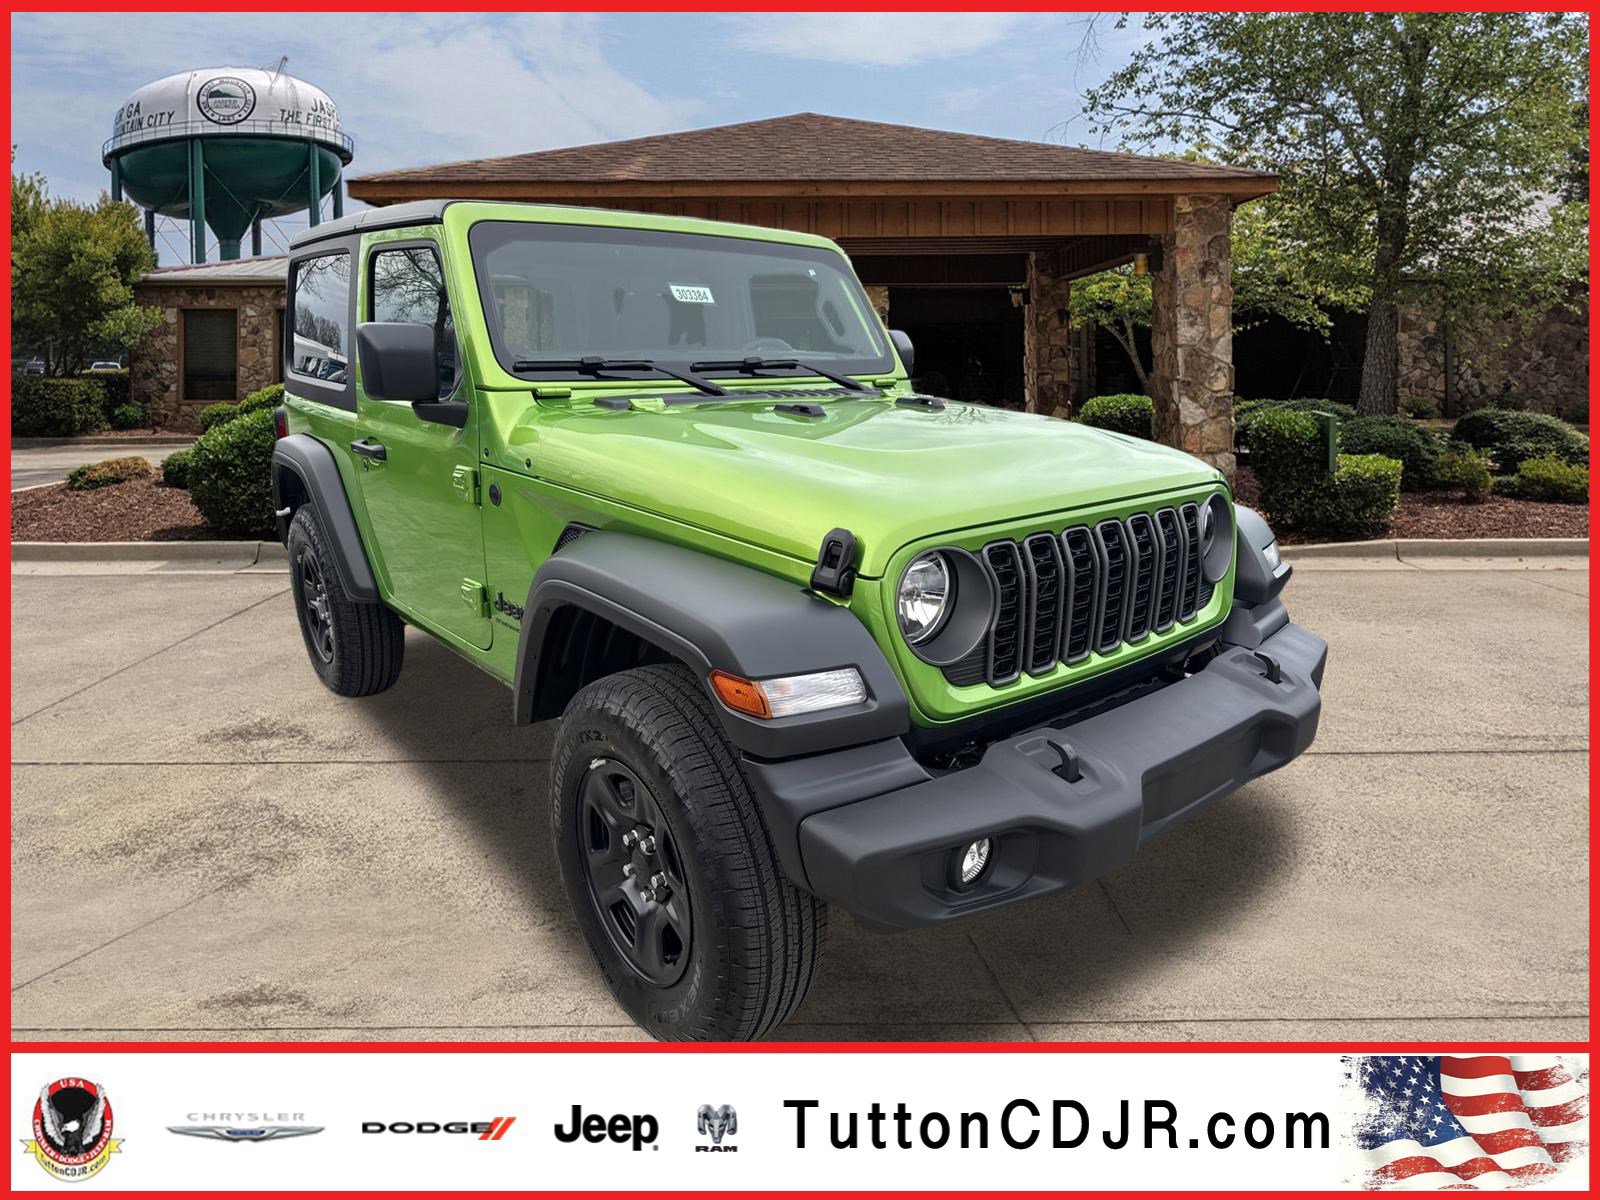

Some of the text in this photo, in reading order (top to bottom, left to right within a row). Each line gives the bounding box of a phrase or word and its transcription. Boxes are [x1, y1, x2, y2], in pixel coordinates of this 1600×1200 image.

[126, 100, 141, 119] GA
[147, 110, 175, 127] CITY
[280, 108, 302, 124] THE
[305, 112, 332, 129] FIRST
[675, 288, 709, 301] 303384
